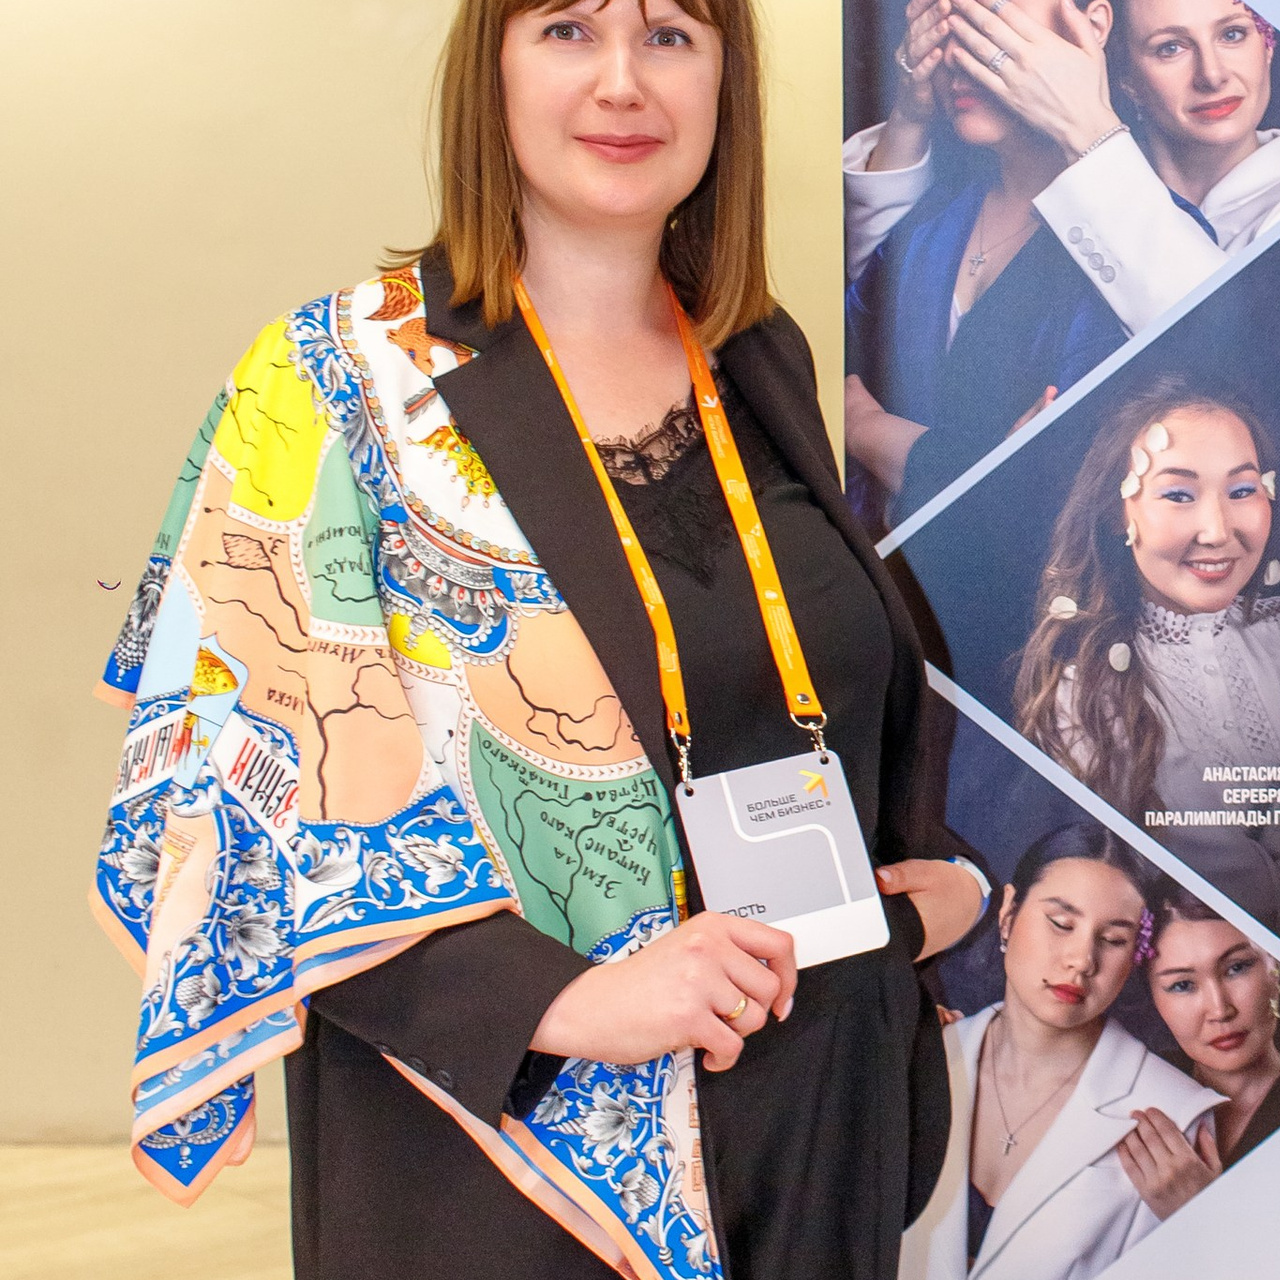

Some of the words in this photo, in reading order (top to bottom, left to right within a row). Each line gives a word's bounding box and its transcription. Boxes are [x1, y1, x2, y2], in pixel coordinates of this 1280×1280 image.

[746, 793, 797, 813] БОЛЬШЕ
[749, 811, 776, 823] ЧЕМ
[777, 799, 824, 818] БИЗНЕС
[1145, 809, 1271, 827] ПАРАЛИМПИАДЫ
[721, 902, 767, 919] ОСТЬ
